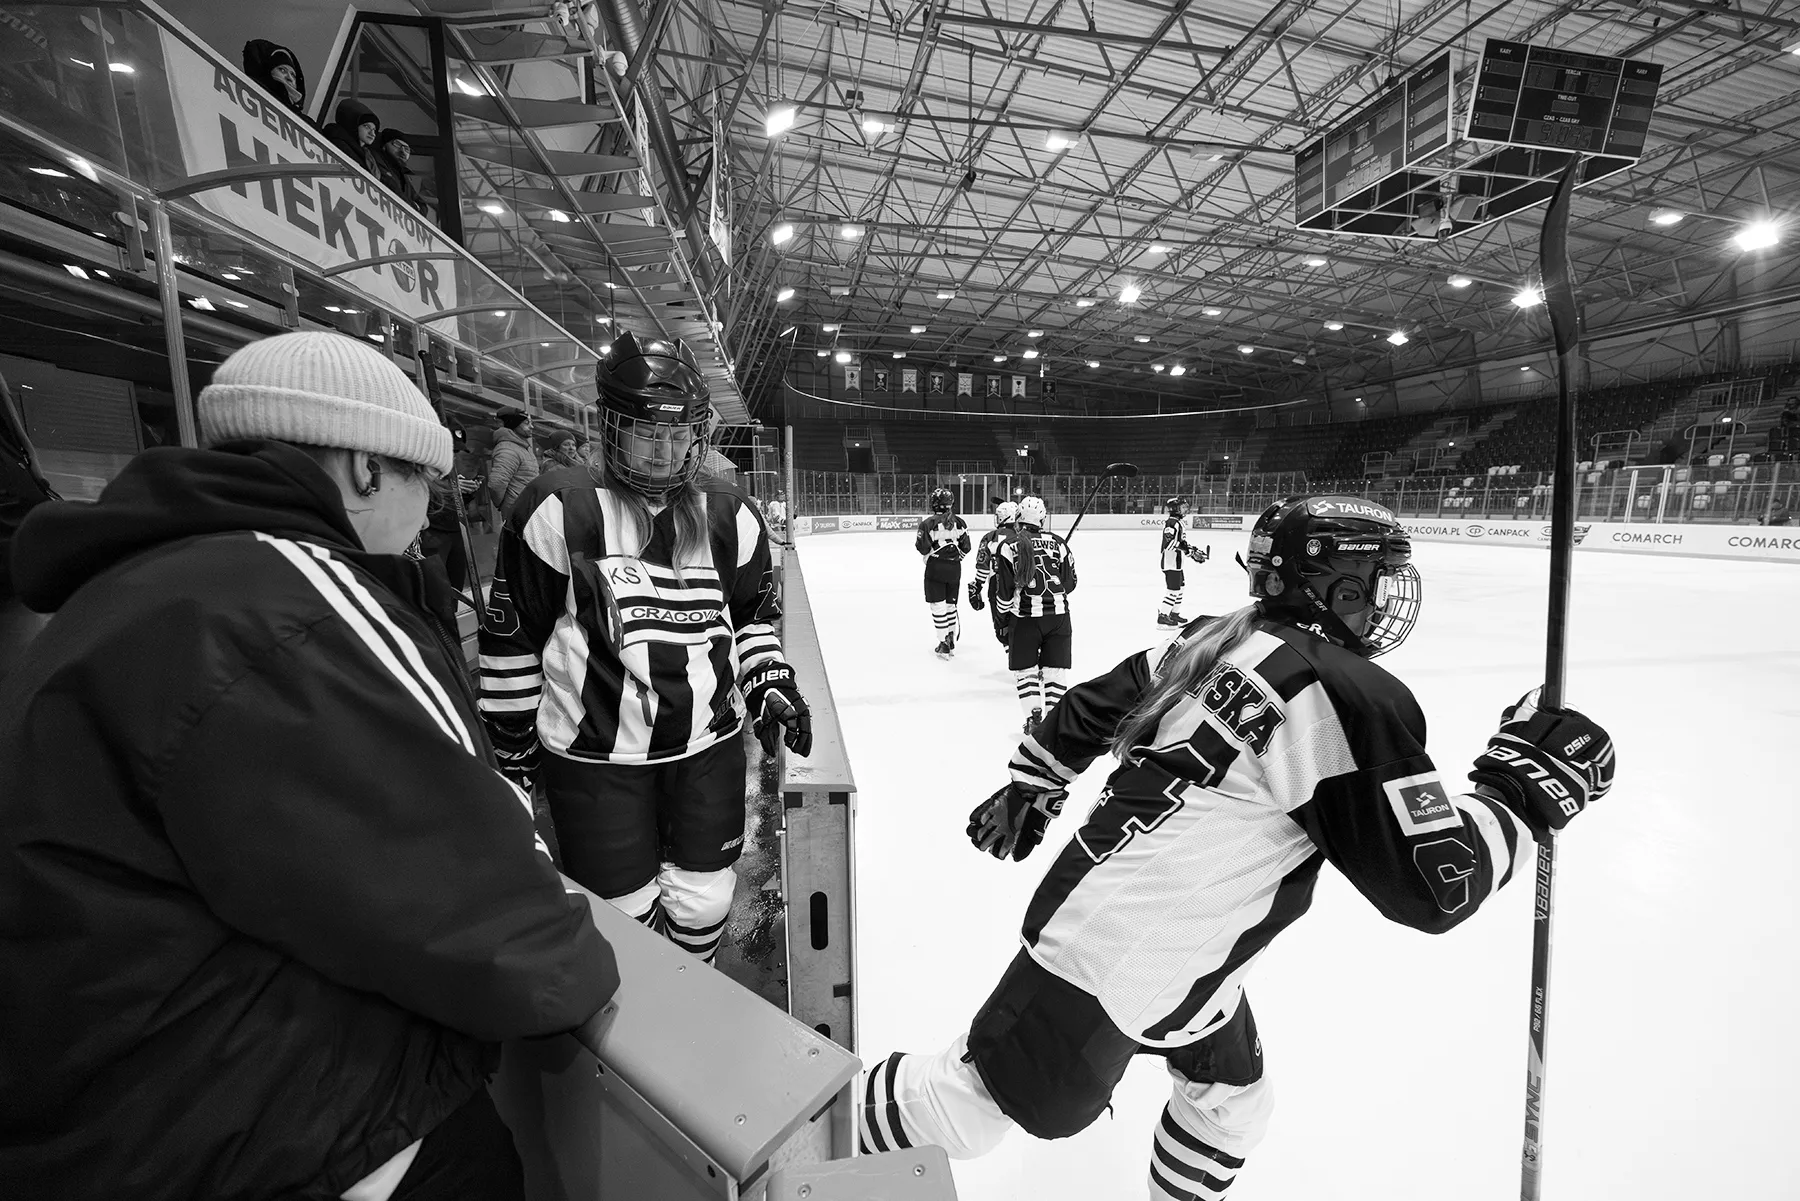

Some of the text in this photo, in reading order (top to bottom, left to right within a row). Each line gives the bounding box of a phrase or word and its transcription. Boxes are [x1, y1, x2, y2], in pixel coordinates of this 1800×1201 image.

[1336, 502, 1393, 523] TAURON
[1487, 528, 1530, 537] CANPACK
[1612, 532, 1683, 545] COMARCH
[1337, 543, 1381, 551] BAUER
[607, 565, 642, 585] KS
[630, 607, 721, 623] CRACOVIA
[742, 668, 791, 698] AUER
[1410, 804, 1450, 818] TAURON
[1536, 844, 1552, 912] BAUER
[1525, 1069, 1542, 1144] SYNC
